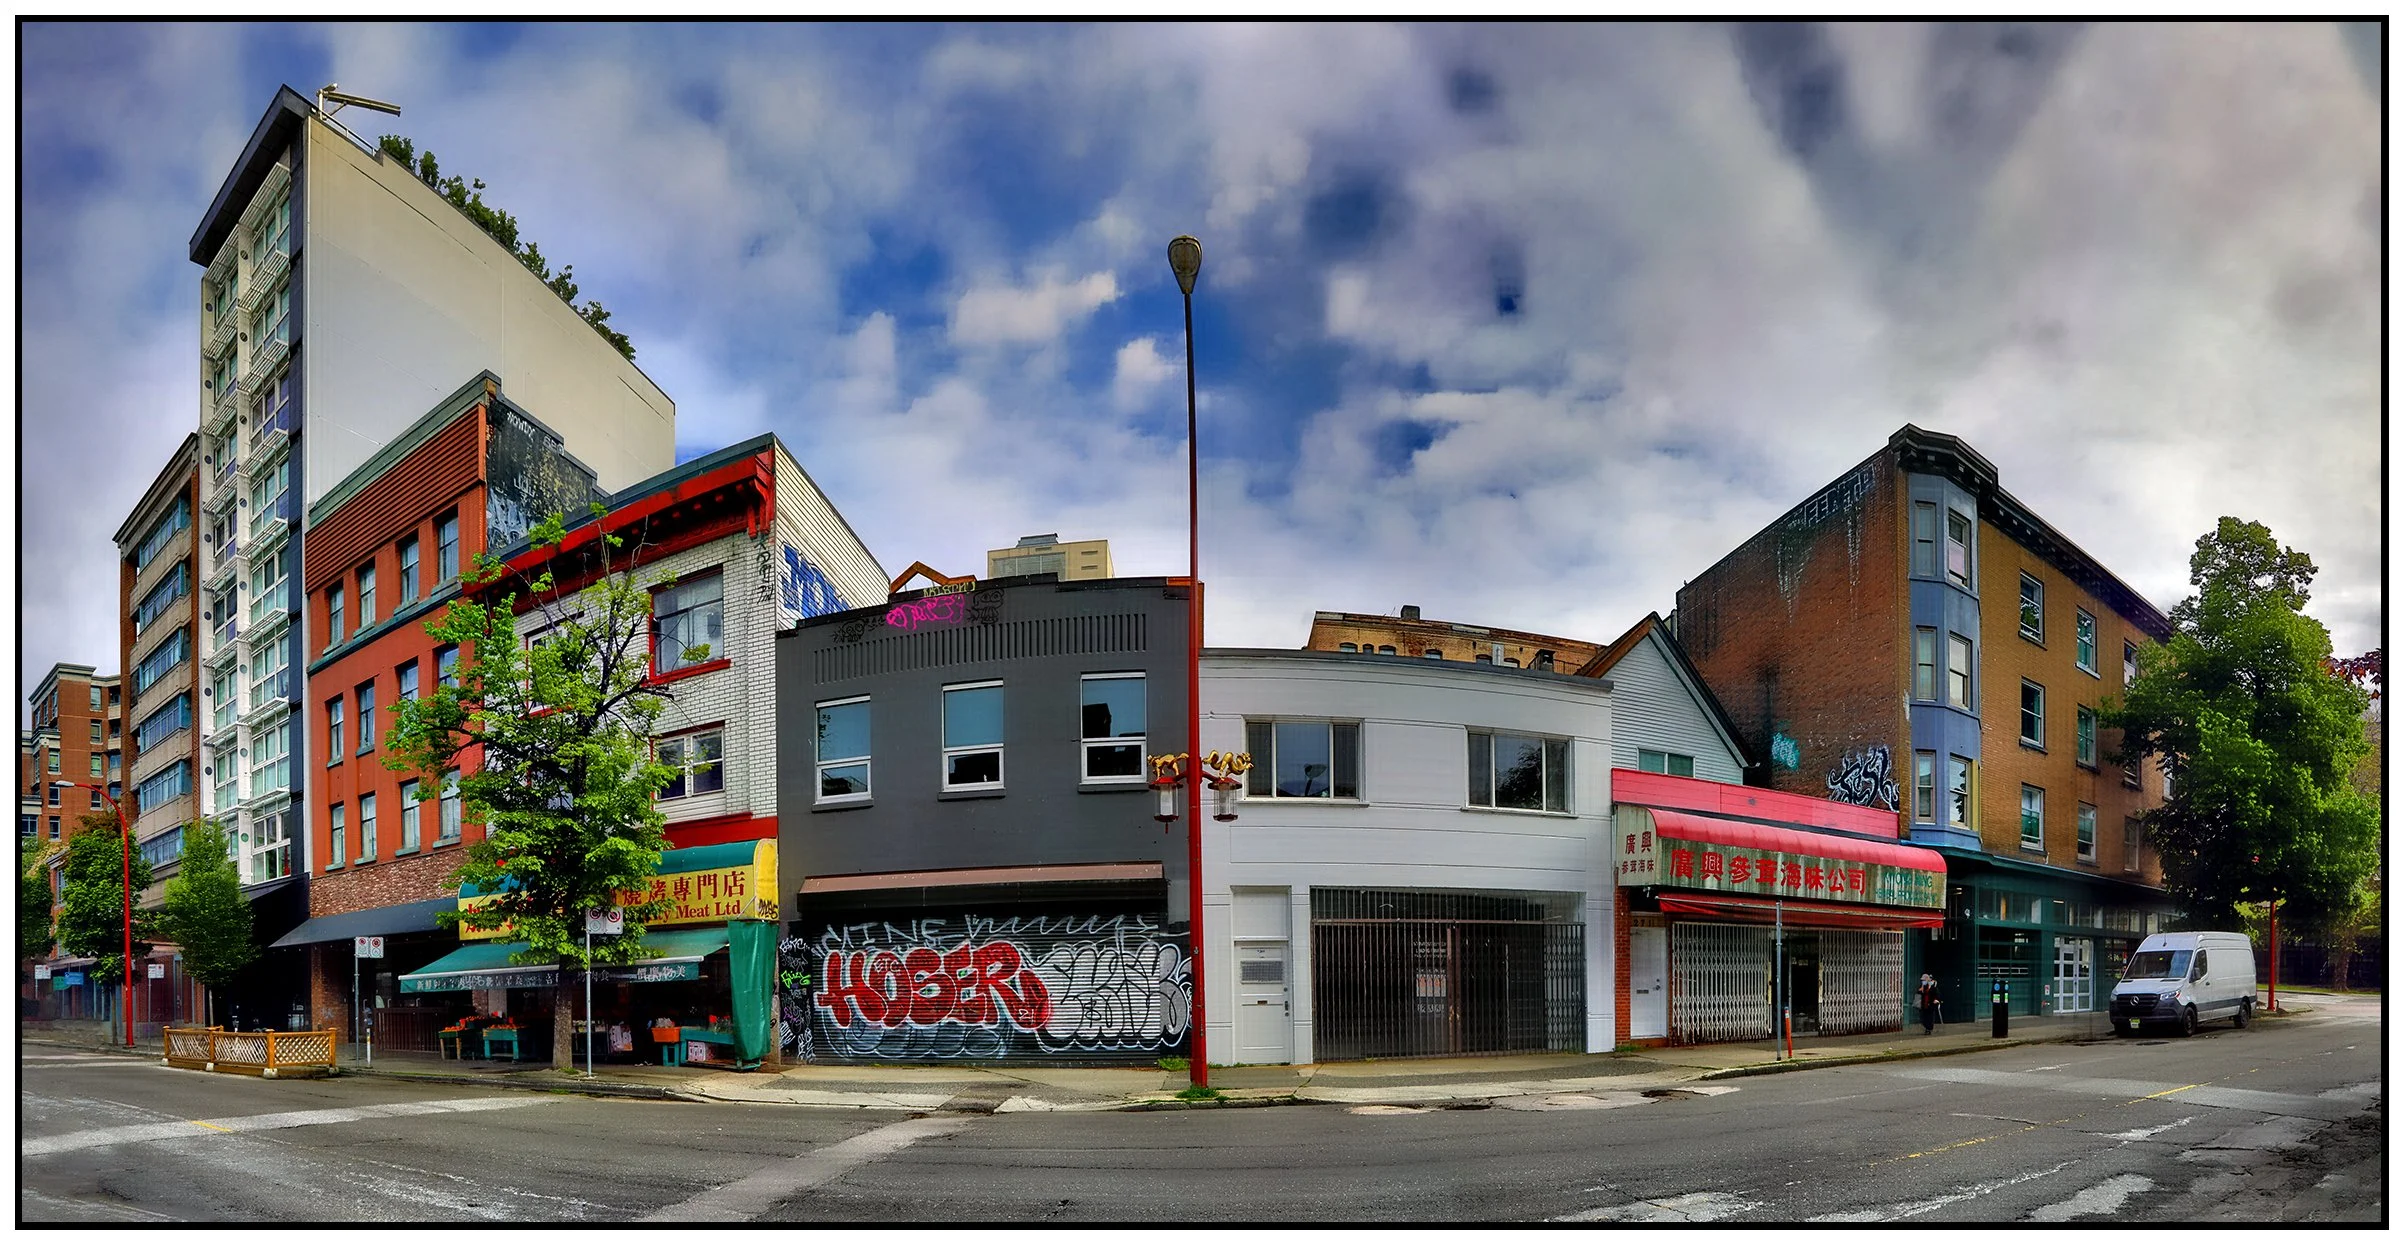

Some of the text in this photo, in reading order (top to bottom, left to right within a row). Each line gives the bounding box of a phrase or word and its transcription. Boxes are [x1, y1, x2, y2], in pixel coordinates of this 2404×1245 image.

[1669, 848, 1866, 895] 廣興參茸海味公司
[675, 904, 710, 919] Meat
[715, 900, 741, 917] Ltd
[812, 939, 1051, 1031] HOSER
